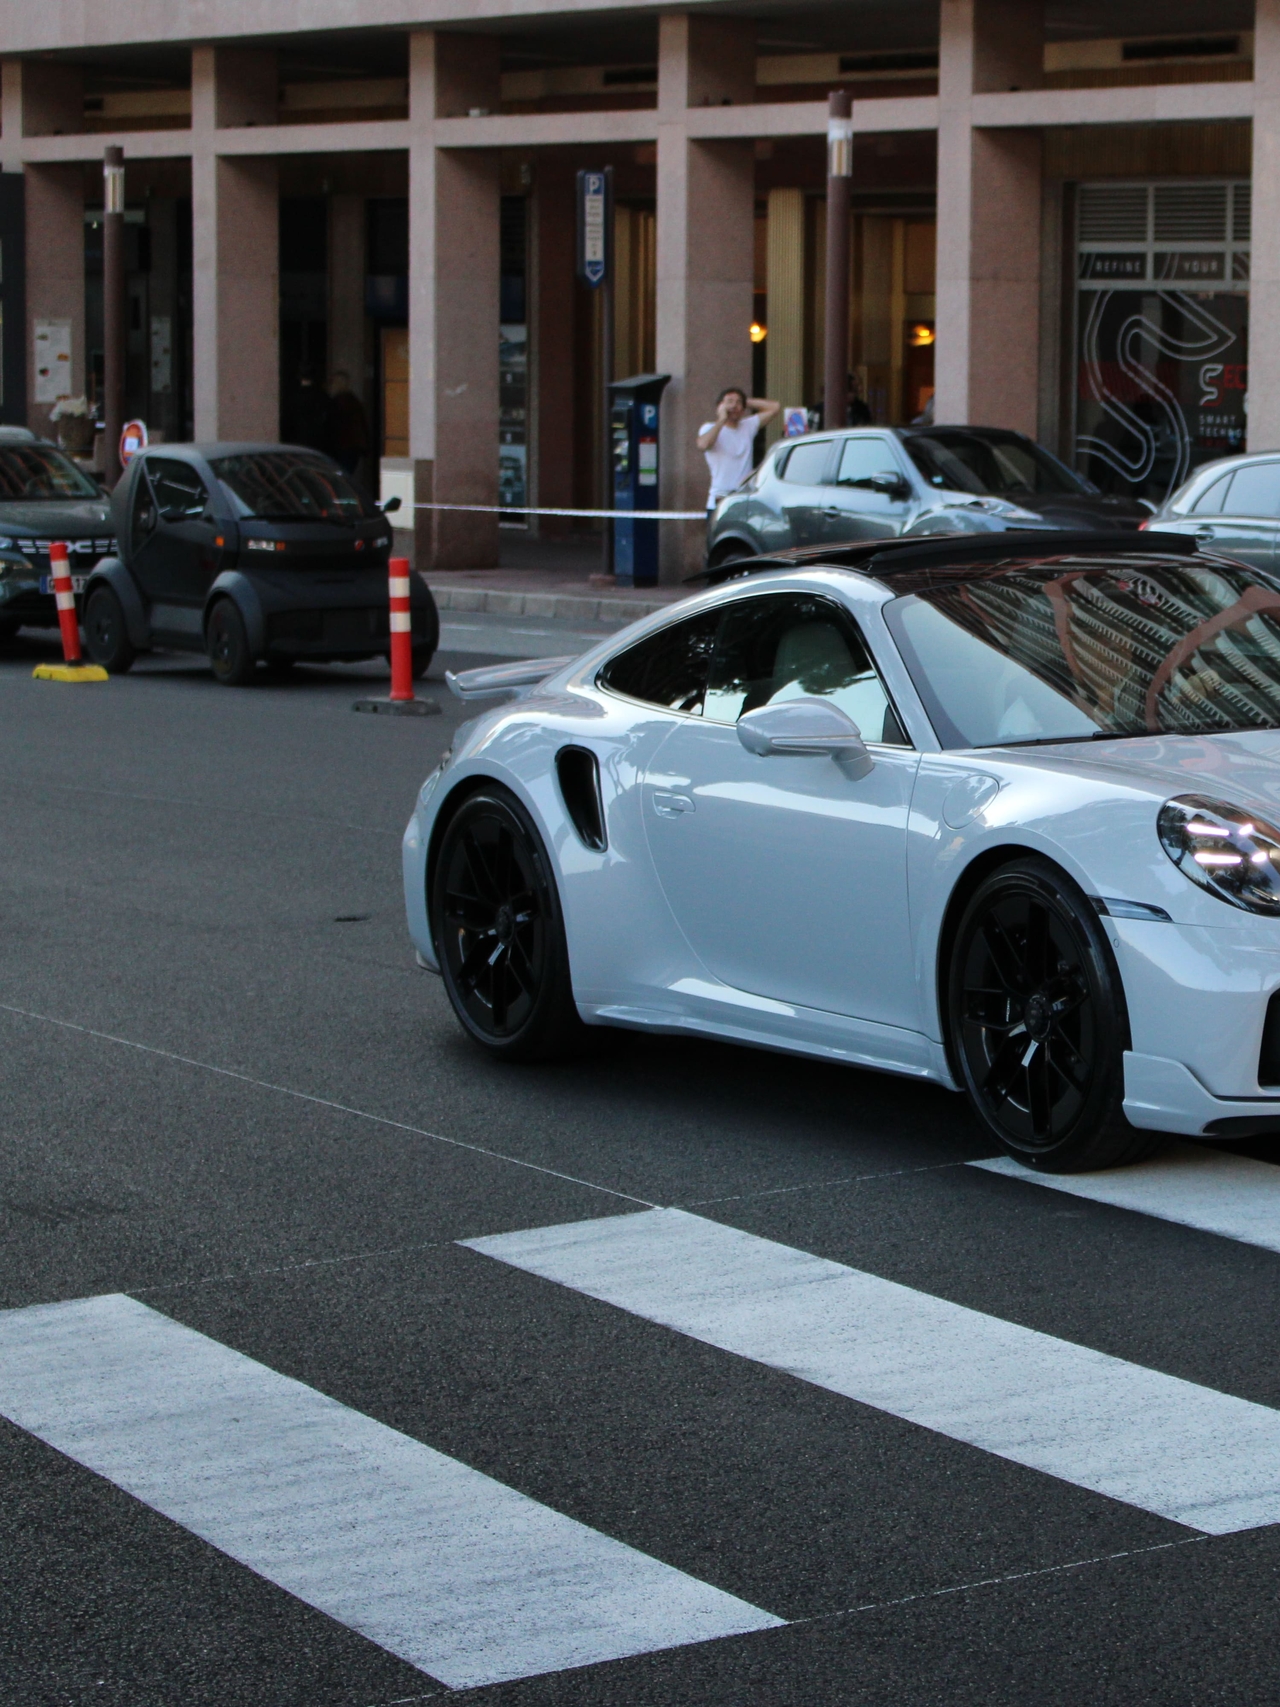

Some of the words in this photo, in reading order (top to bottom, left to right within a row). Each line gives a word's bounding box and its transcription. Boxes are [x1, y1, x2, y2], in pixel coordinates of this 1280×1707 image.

[589, 175, 600, 195] P
[1095, 260, 1141, 273] REFINE
[1183, 260, 1218, 273] YOUR
[644, 404, 656, 425] P
[1199, 414, 1236, 425] SMART
